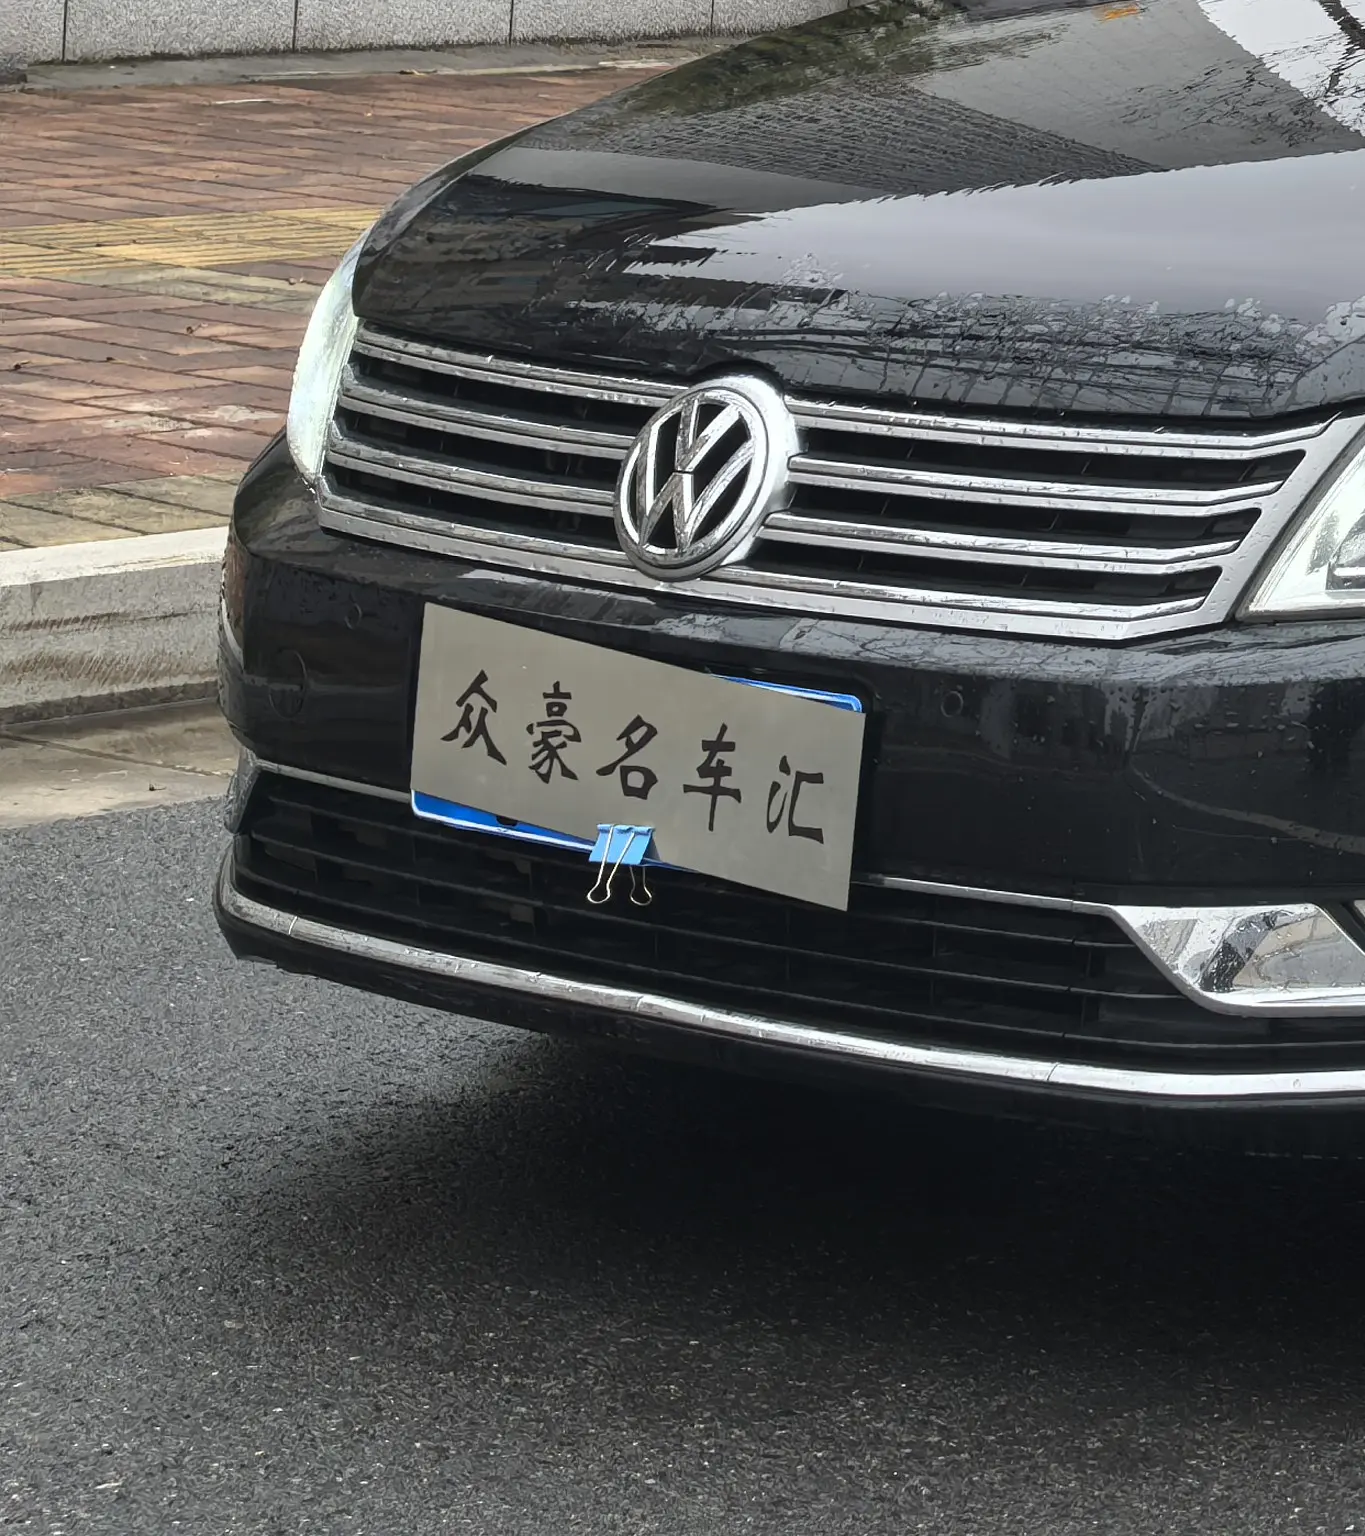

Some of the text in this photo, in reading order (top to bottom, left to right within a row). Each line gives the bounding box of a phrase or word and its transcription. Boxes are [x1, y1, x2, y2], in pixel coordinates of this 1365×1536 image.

[440, 669, 825, 845] 众豪名车汇
